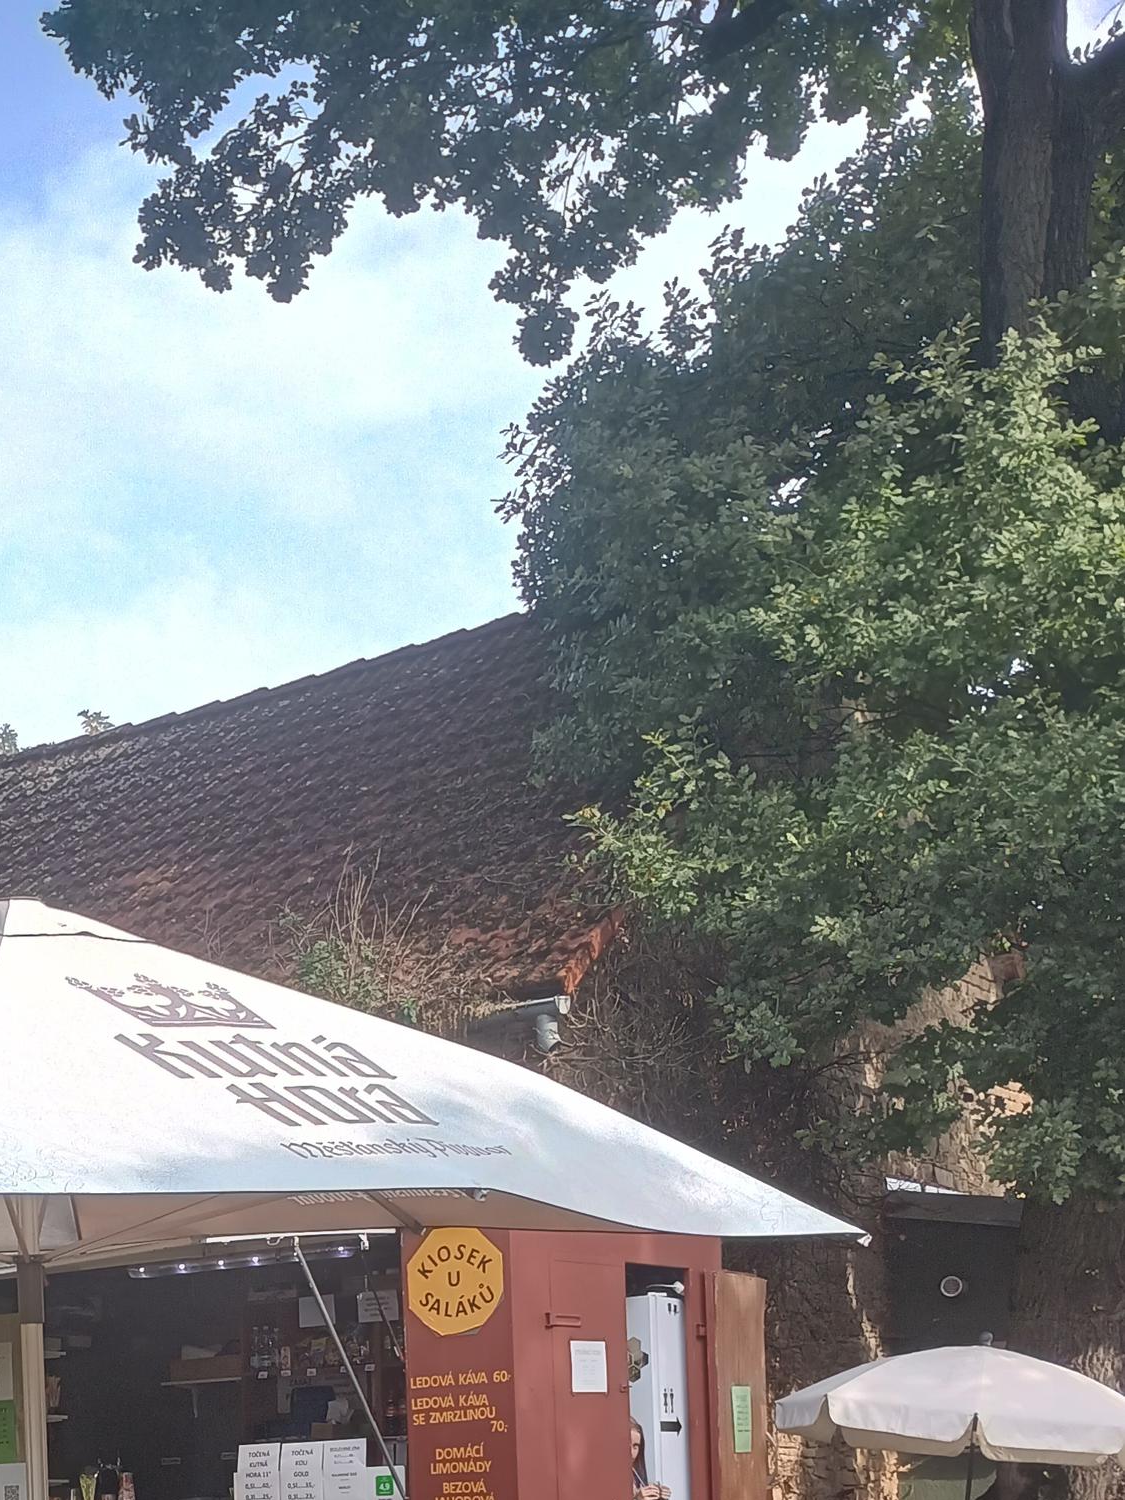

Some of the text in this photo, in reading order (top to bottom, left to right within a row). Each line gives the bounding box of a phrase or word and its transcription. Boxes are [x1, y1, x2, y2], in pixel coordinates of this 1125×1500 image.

[114, 1033, 397, 1080] Kutná
[226, 1082, 440, 1127] Hora
[417, 1244, 493, 1279] KIOSEK
[448, 1271, 460, 1287] U
[419, 1283, 494, 1317] SALÁKŮ
[410, 1370, 455, 1389] LEDOVÁ
[458, 1369, 488, 1385] KÁVA
[411, 1391, 489, 1410] LEDOVÁ KÁVA
[413, 1406, 496, 1426] SE ZMRZLINOU
[435, 1441, 484, 1460] DOMÁCÍ
[430, 1458, 492, 1475] LIMONÁDY
[442, 1478, 487, 1494] BEZOVÁ
